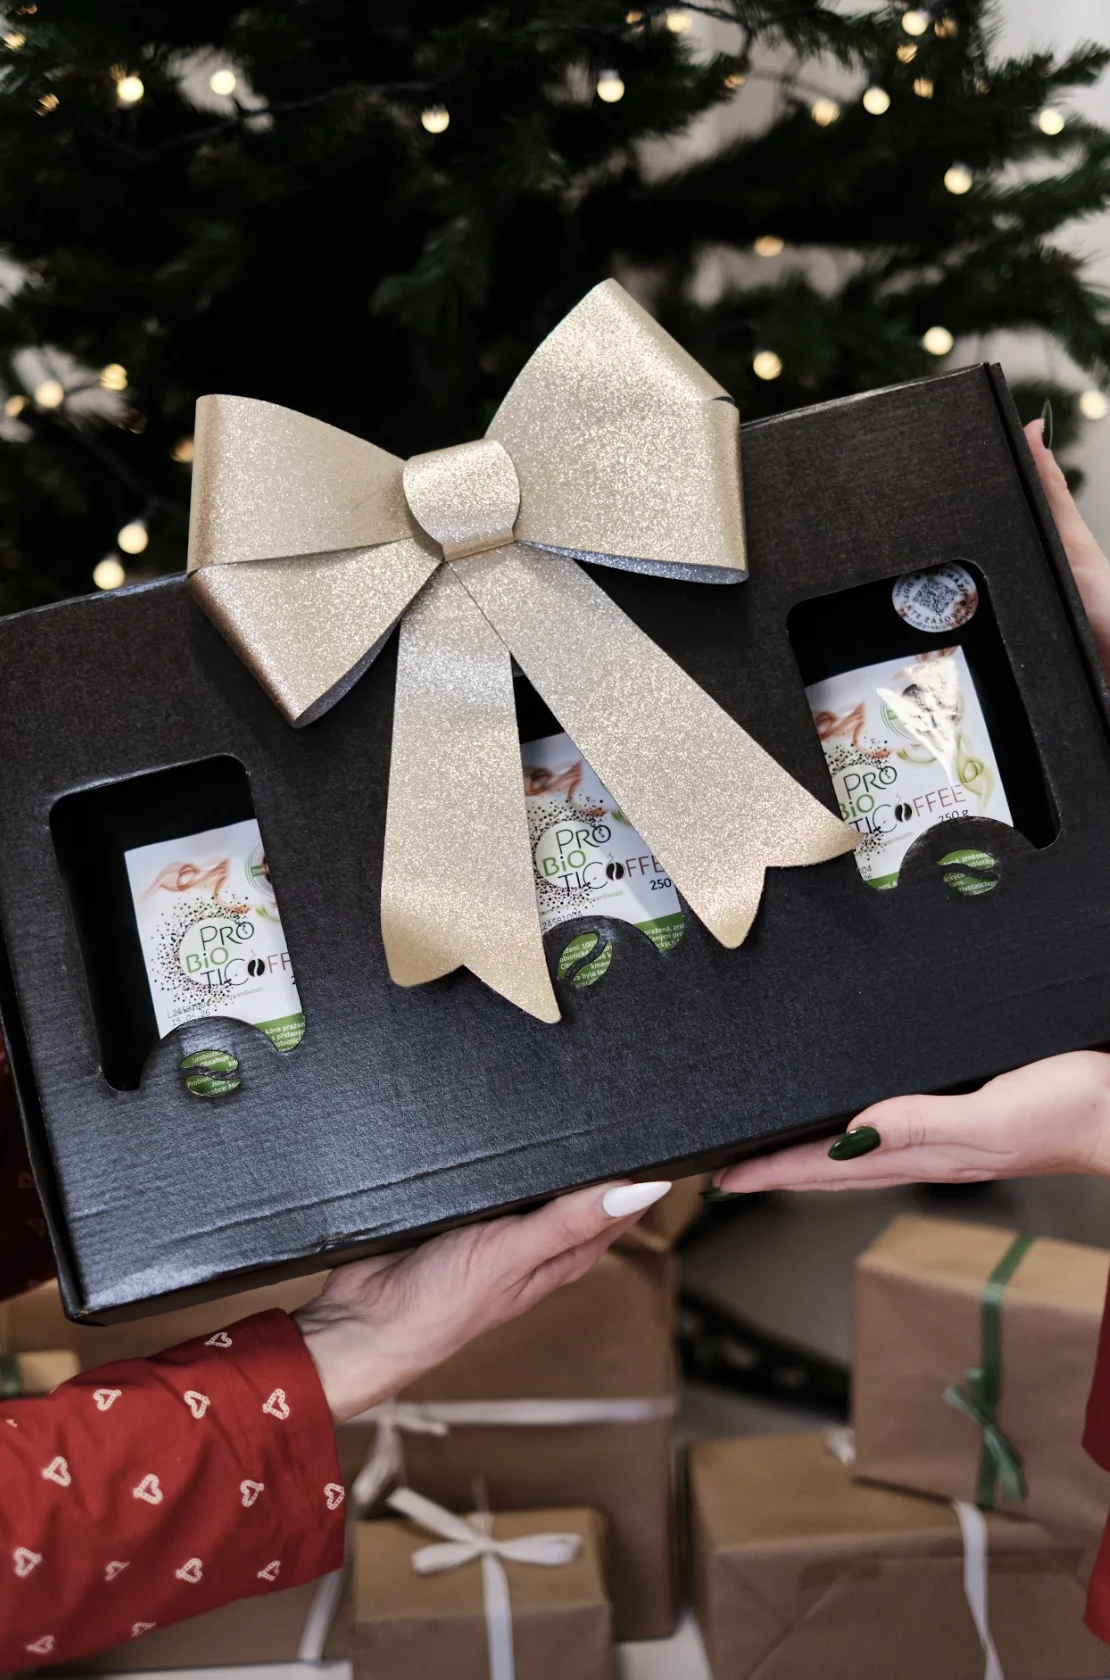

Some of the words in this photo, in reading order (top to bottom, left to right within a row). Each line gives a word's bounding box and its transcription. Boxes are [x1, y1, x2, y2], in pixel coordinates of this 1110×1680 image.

[844, 766, 897, 799] PRO
[556, 825, 611, 854] PRO
[542, 850, 586, 876] BiO
[650, 878, 671, 890] 250
[200, 921, 254, 951] PRO
[186, 947, 228, 973] BiO
